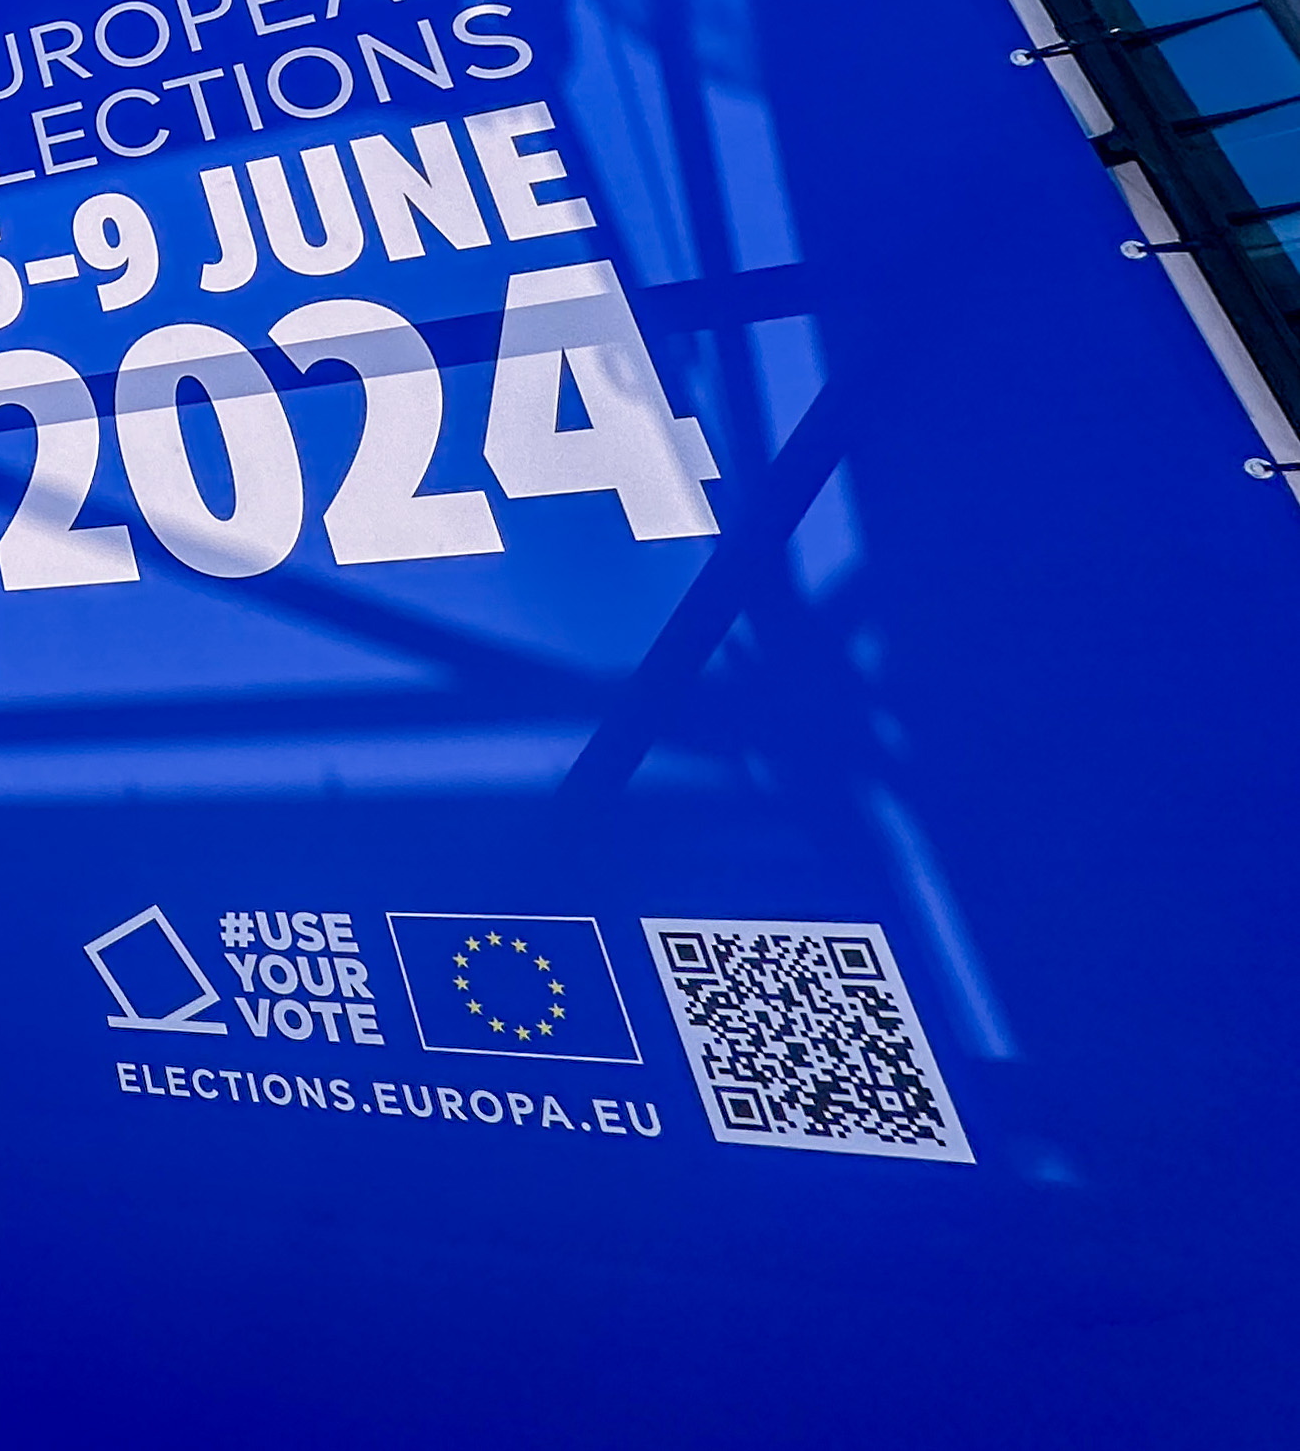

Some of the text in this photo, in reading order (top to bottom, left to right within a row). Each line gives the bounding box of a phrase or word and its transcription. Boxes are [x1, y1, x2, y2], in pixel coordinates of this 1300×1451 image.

[200, 101, 596, 292] JUNE
[220, 912, 359, 952] #USE
[224, 953, 374, 998] YOUR
[235, 997, 384, 1044] VOTE
[117, 1063, 661, 1136] ELECTIONS.EUROPA.EU
